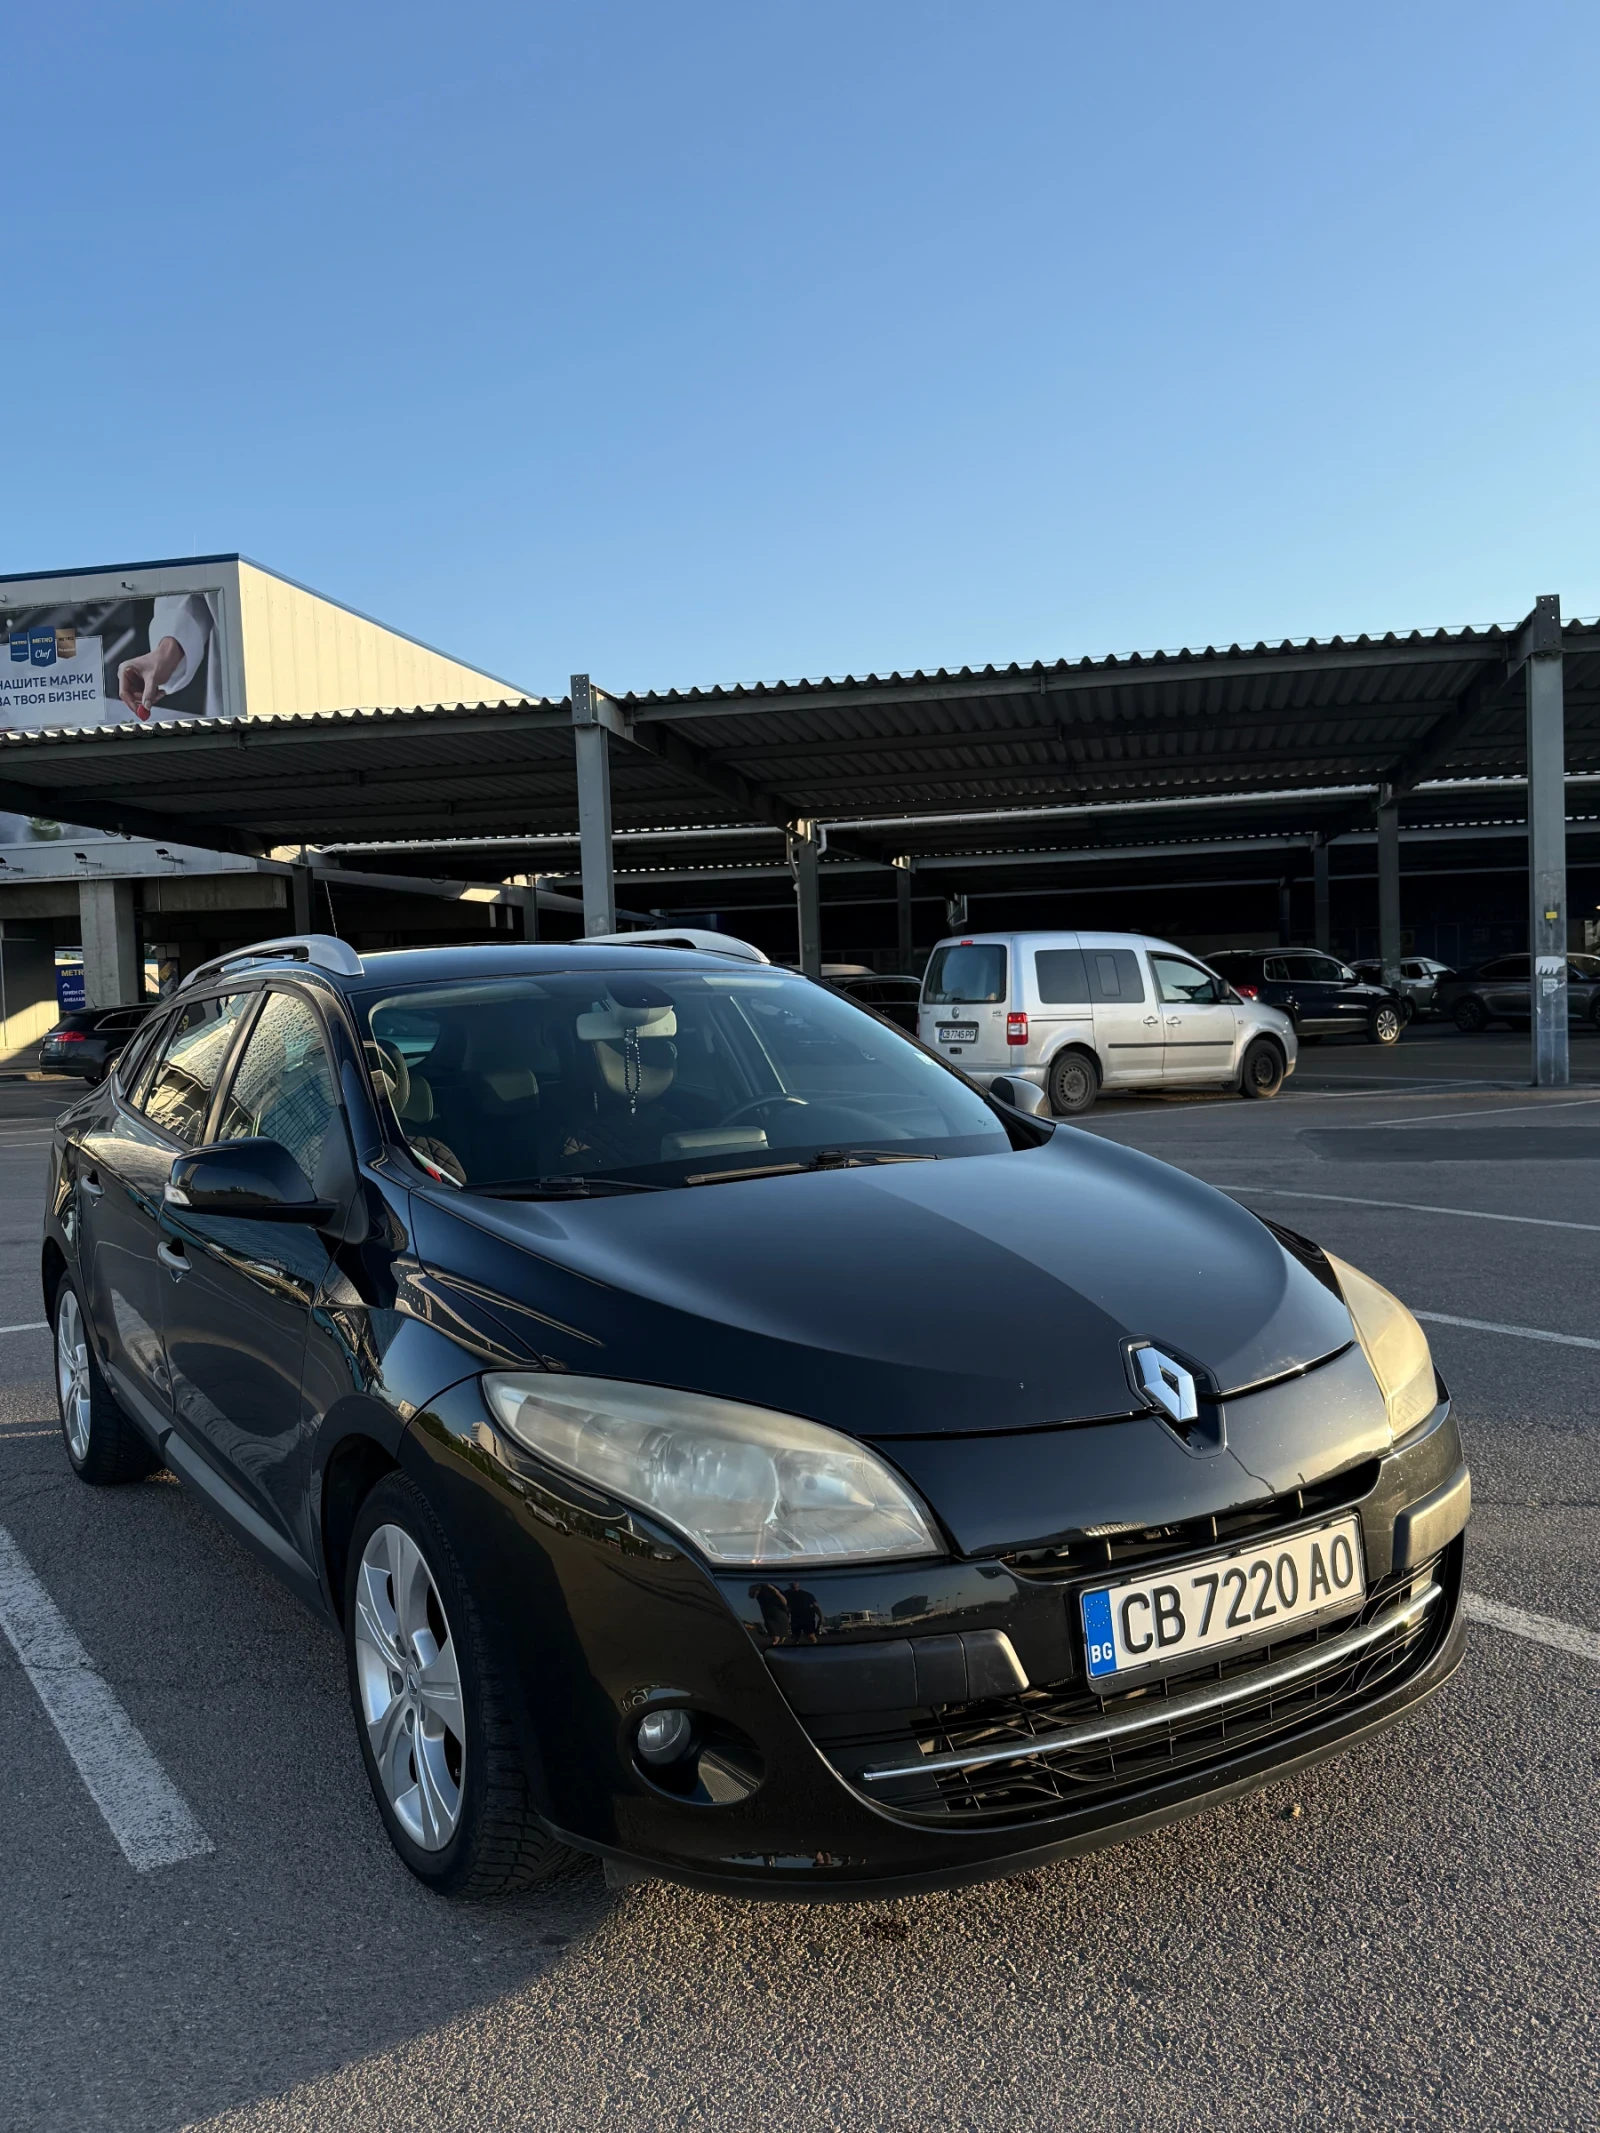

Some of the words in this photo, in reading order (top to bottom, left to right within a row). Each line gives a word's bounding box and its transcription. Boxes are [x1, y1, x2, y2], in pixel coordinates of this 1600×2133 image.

[32, 636, 53, 644] METRO
[35, 648, 52, 659] Chef
[49, 673, 93, 687] МАРКИ
[13, 693, 46, 706] ТВОЯ
[48, 689, 96, 703] БИЗНЕС
[1121, 1584, 1186, 1654] CB
[1192, 1552, 1299, 1637] 7220
[1310, 1533, 1354, 1601] AO
[1090, 1641, 1113, 1664] BG
